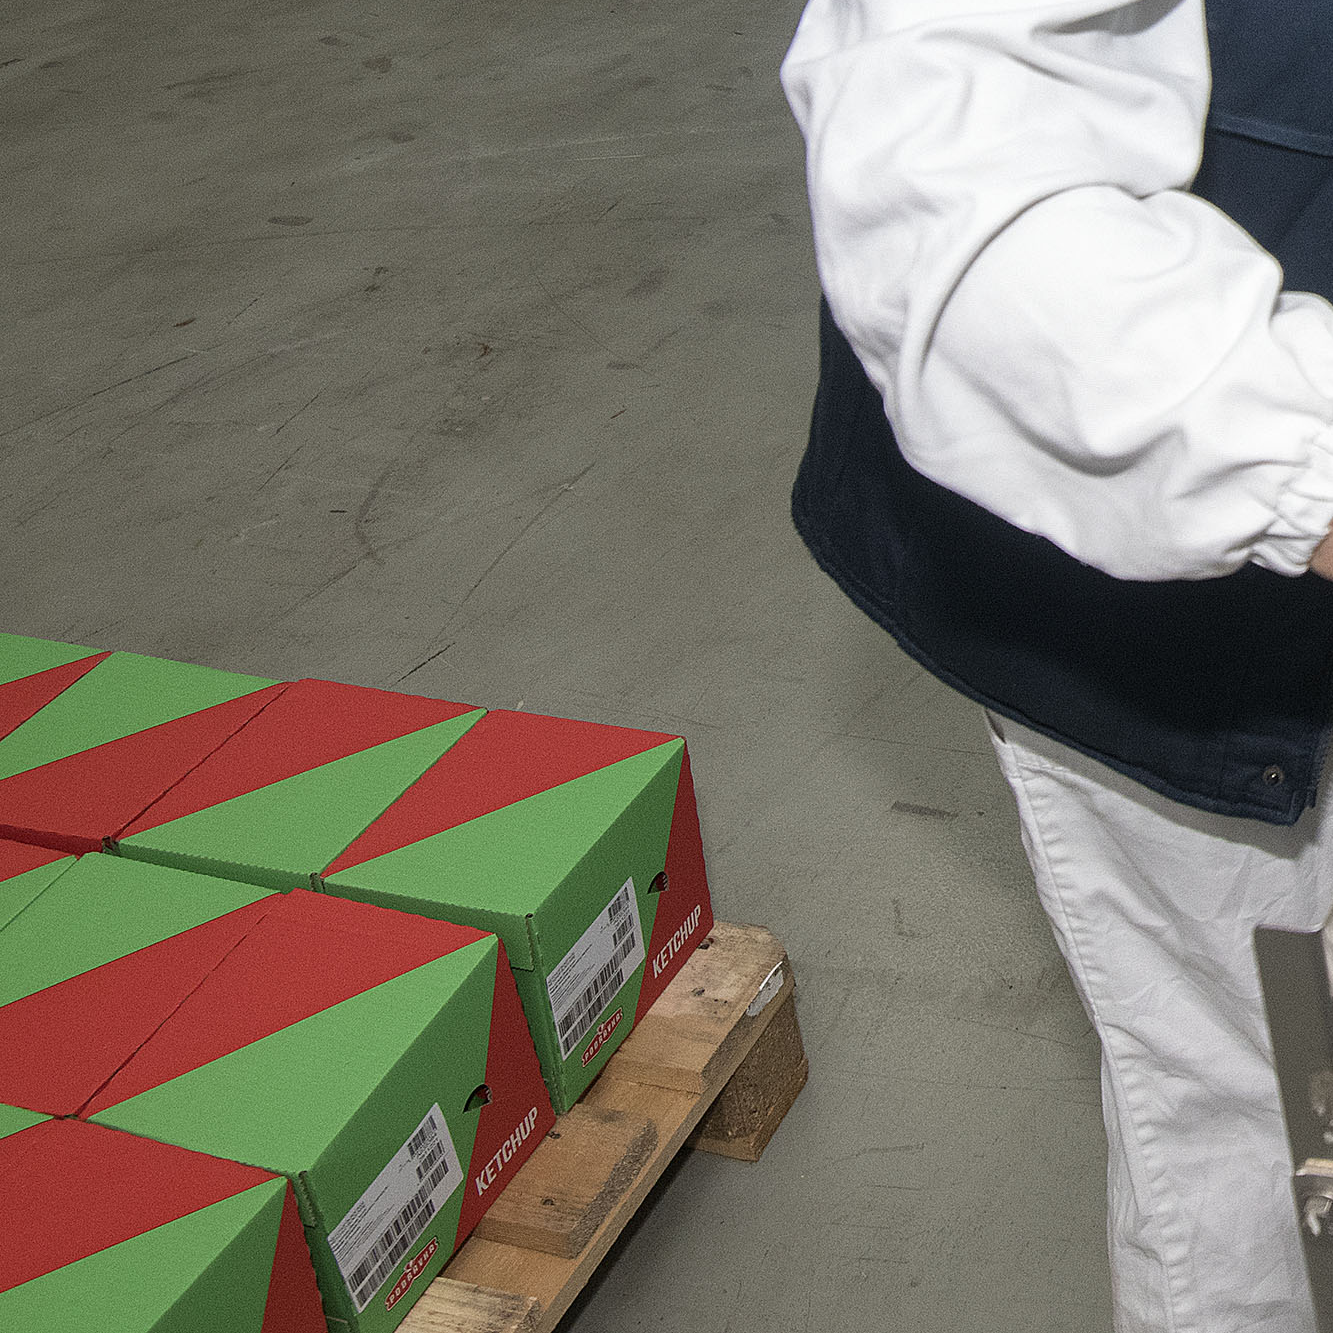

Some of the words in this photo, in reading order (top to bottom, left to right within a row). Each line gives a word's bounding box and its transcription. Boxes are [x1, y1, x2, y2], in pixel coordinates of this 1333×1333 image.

[652, 904, 701, 979] KETCHUP
[474, 1106, 538, 1196] KETCHUP
[388, 1244, 436, 1304] PODRAVKA
